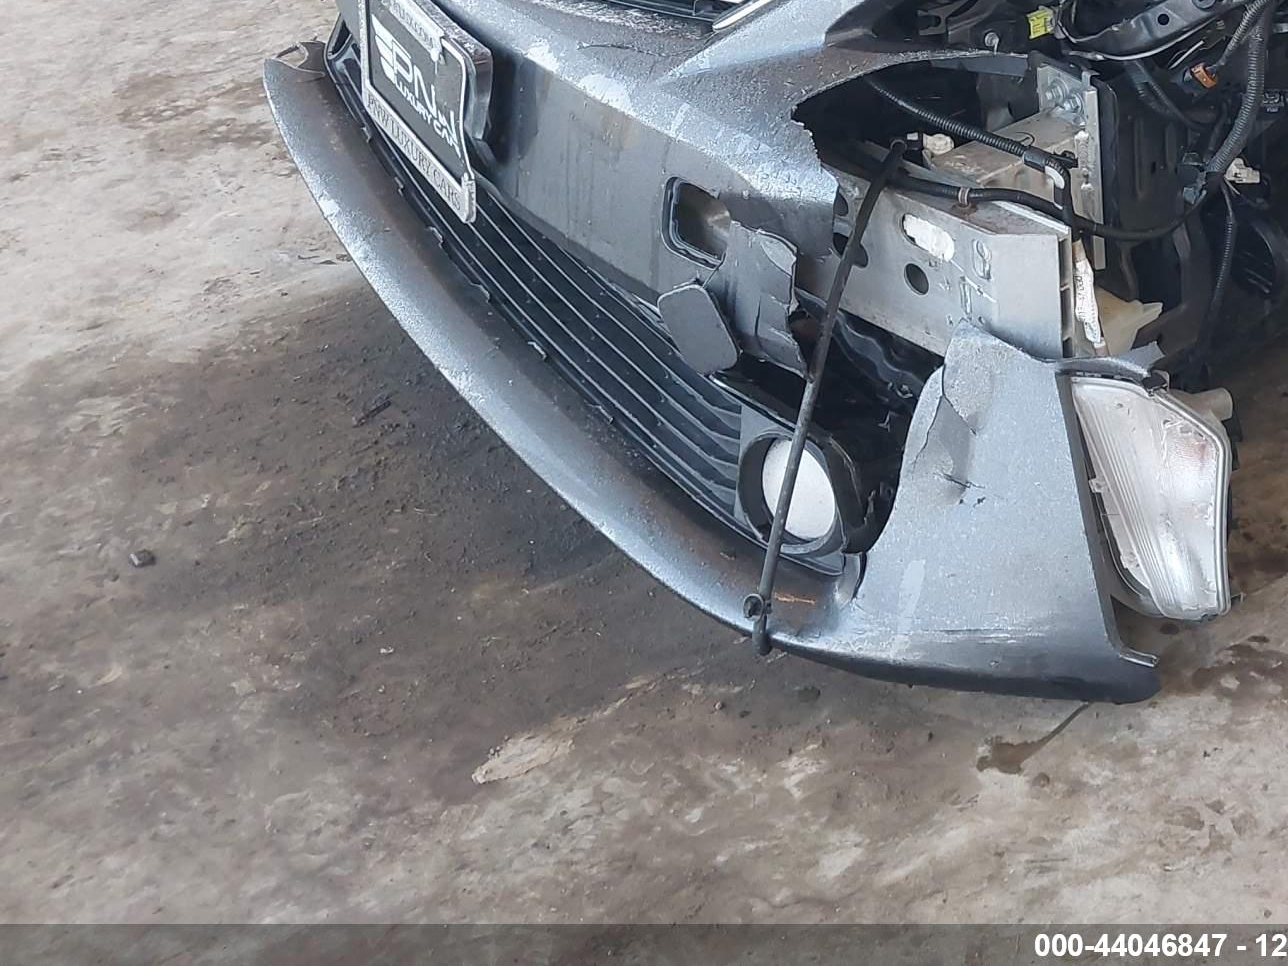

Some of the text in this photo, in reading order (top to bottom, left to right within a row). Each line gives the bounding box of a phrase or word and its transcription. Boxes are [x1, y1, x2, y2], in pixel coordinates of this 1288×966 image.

[395, 79, 432, 124] LUXURY
[367, 93, 461, 211] PNW LUXURY CARS
